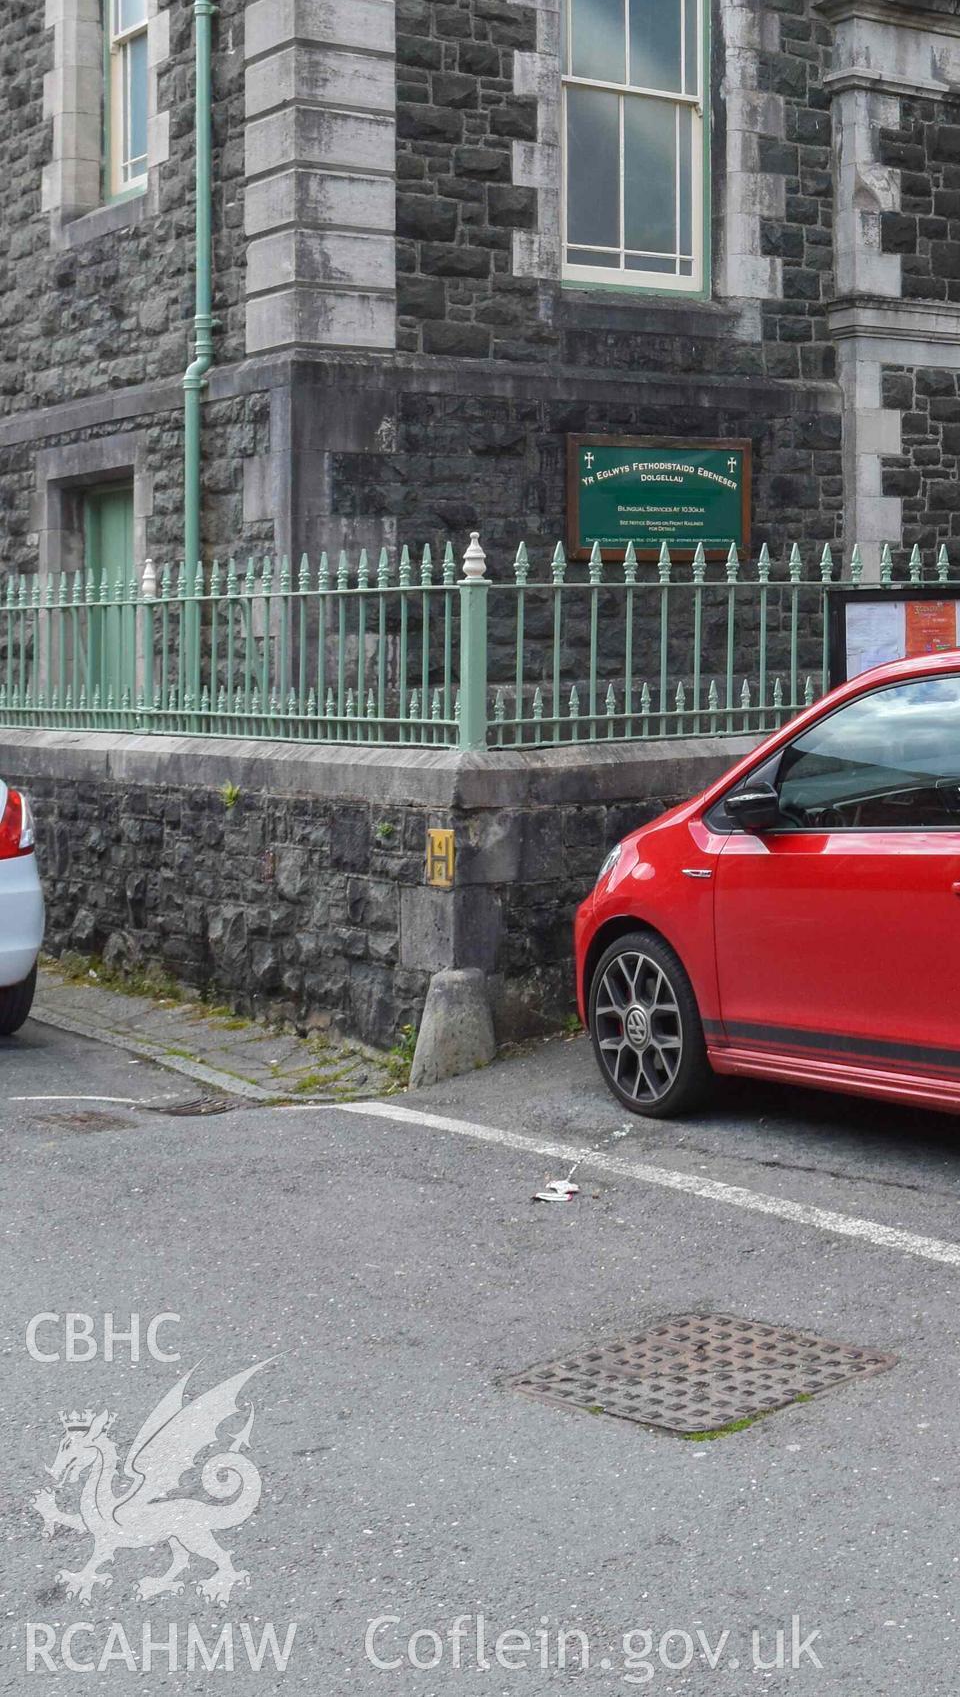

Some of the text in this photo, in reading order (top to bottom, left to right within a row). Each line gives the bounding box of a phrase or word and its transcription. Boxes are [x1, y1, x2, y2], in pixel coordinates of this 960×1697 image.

[582, 462, 738, 490] YR EGLWYS FETHODISTAIDD EBENESER
[640, 473, 684, 483] DOLGELLAU
